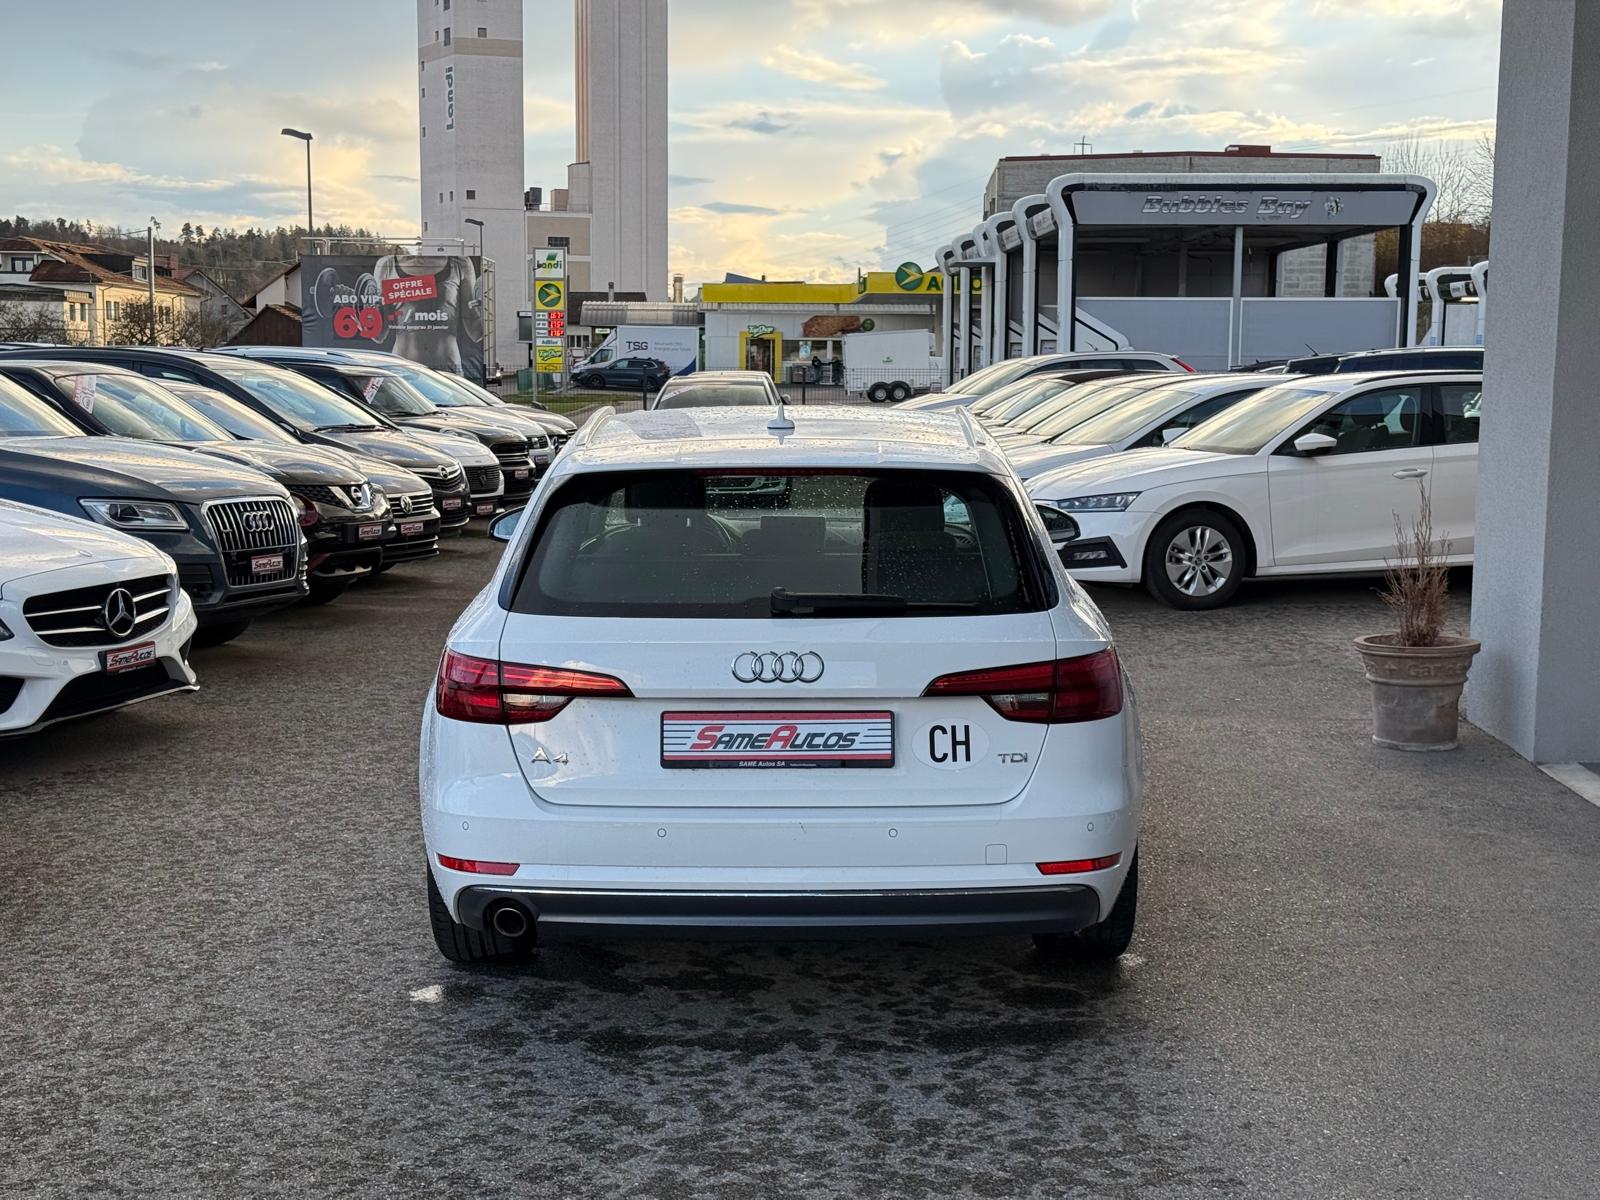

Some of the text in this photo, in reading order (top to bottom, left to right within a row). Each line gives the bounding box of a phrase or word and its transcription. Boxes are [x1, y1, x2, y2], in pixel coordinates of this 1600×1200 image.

[445, 66, 454, 130] Landi
[1142, 195, 1311, 219] Bubbles Bay
[537, 260, 562, 270] Landi
[392, 279, 423, 290] OFFRE
[333, 294, 358, 304] ABO
[388, 287, 433, 300] SPÉCIALE
[414, 309, 449, 322] mois
[626, 341, 649, 351] TSG
[928, 724, 971, 763] CH
[531, 746, 569, 765] A4
[998, 752, 1029, 764] TDI
